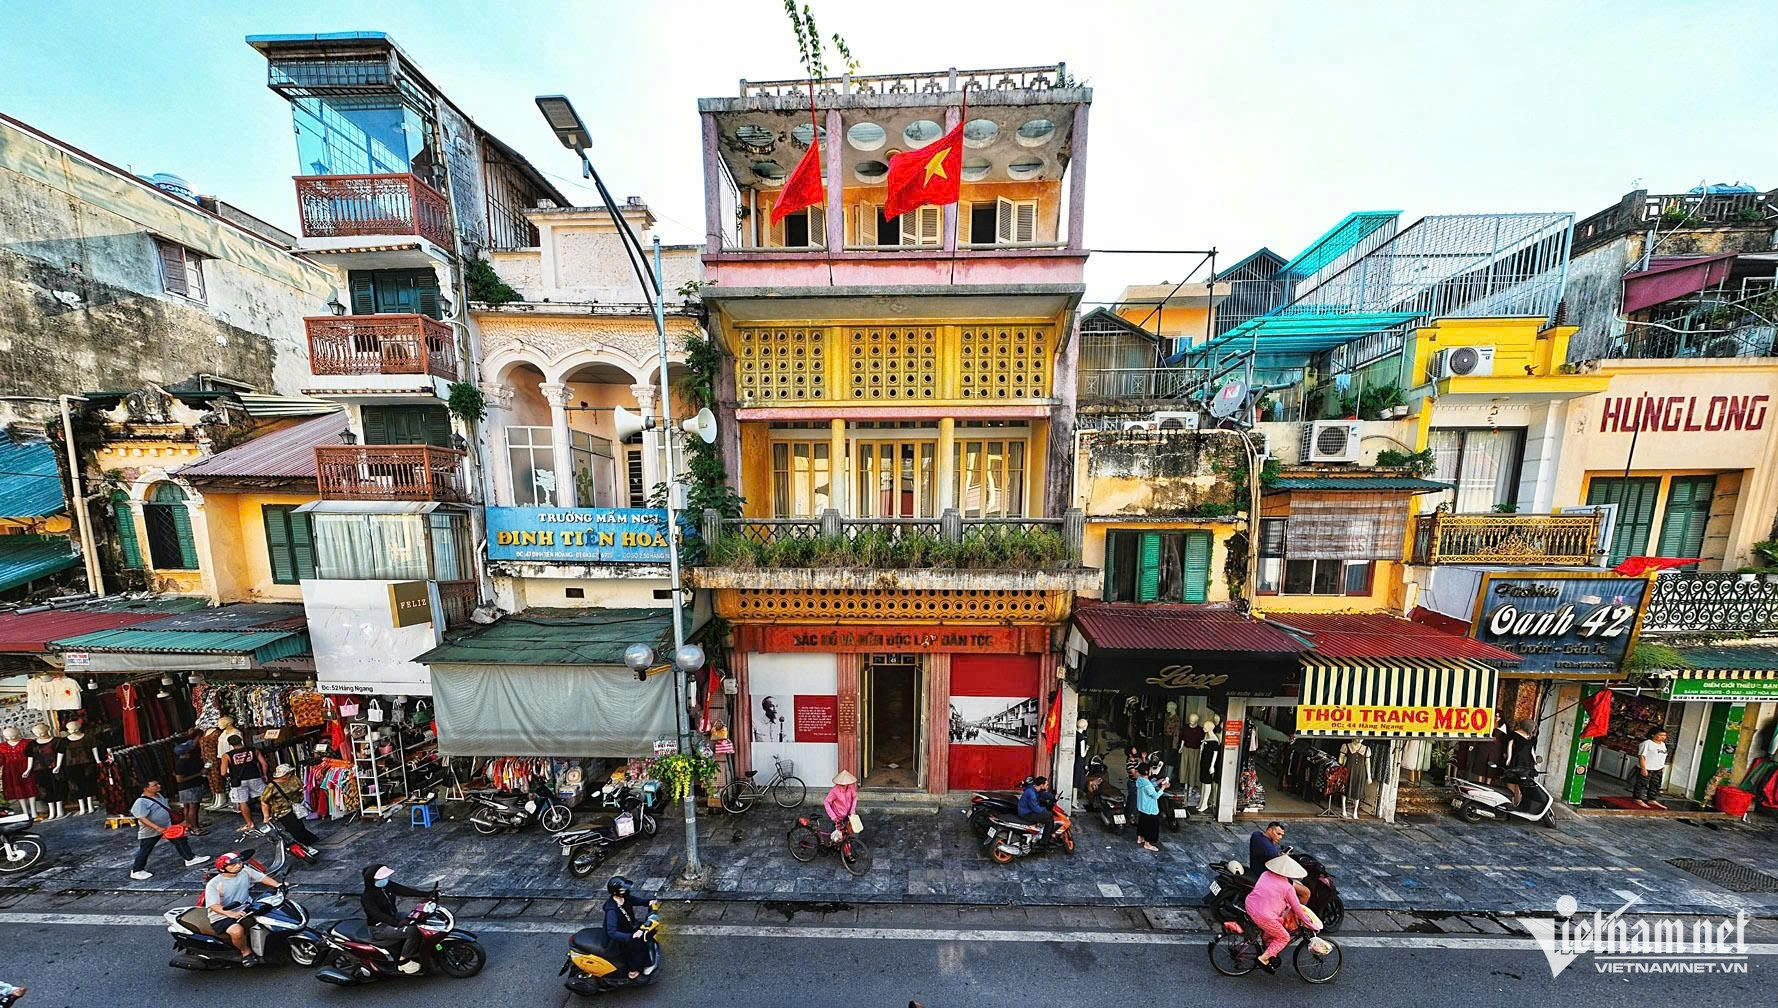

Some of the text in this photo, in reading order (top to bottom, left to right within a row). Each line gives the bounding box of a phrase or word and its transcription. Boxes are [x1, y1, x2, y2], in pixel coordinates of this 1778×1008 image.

[1600, 391, 1770, 432] HƯNG LONG
[538, 512, 592, 523] TRƯỜNG
[596, 510, 628, 523] MẦM
[497, 530, 554, 546] ĐINH
[560, 527, 614, 547] TIÊN
[400, 599, 427, 609] FELIZ
[1490, 604, 1635, 638] Oanh 42
[840, 632, 855, 646] VÀ
[1303, 706, 1488, 731] THỜI TRANG MEO
[1359, 722, 1378, 730] Hàng
